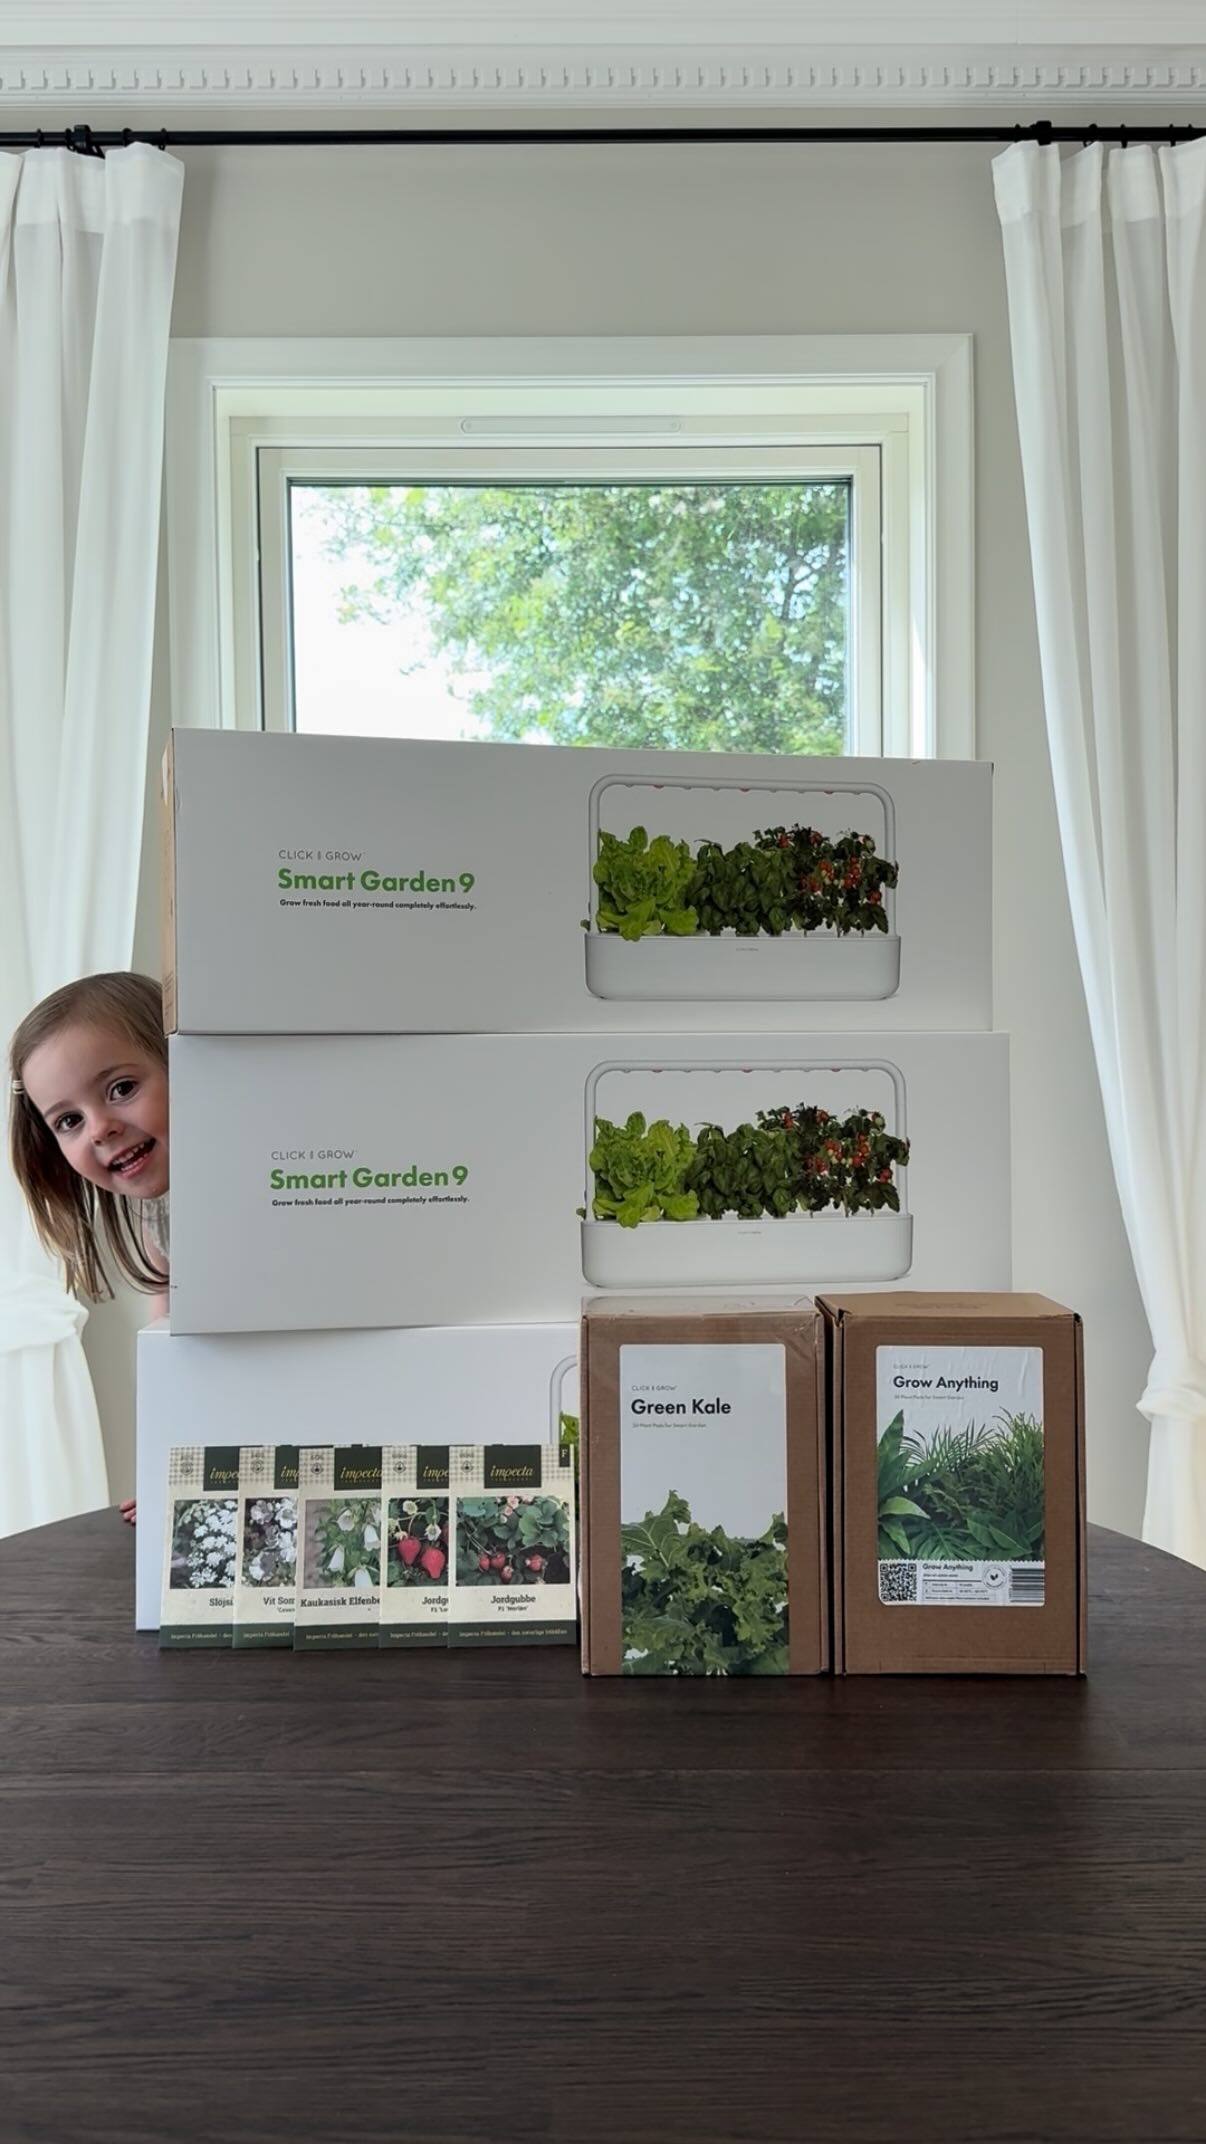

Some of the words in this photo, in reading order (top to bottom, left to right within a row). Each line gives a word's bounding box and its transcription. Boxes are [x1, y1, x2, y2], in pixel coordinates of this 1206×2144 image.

[278, 849, 313, 860] CLICK
[325, 851, 362, 861] GROW
[278, 868, 355, 890] Smart
[360, 870, 455, 893] Garden
[459, 872, 475, 893] 9
[279, 899, 301, 907] Grow
[303, 898, 321, 907] fresh
[323, 899, 340, 908] food
[342, 899, 352, 908] all
[352, 900, 394, 910] year-round
[395, 901, 434, 911] completely
[271, 1150, 306, 1161] CLICK
[317, 1149, 354, 1160] GROW
[270, 1168, 348, 1190] Smart
[352, 1165, 449, 1188] Garden
[452, 1165, 469, 1186] 9
[272, 1199, 293, 1207] Grow
[295, 1198, 314, 1207] fresh
[314, 1197, 332, 1206] food
[334, 1197, 344, 1206] all
[387, 1195, 427, 1206] completely
[893, 1375, 932, 1389] Grow
[936, 1375, 999, 1392] Anything
[631, 1398, 687, 1415] Green
[692, 1396, 732, 1415] Kale
[490, 1465, 533, 1481] impecta
[943, 1563, 974, 1572] Anything
[263, 1596, 276, 1605] Vit
[300, 1597, 347, 1608] Kaukasisk
[490, 1594, 536, 1605] Jordgubbe
